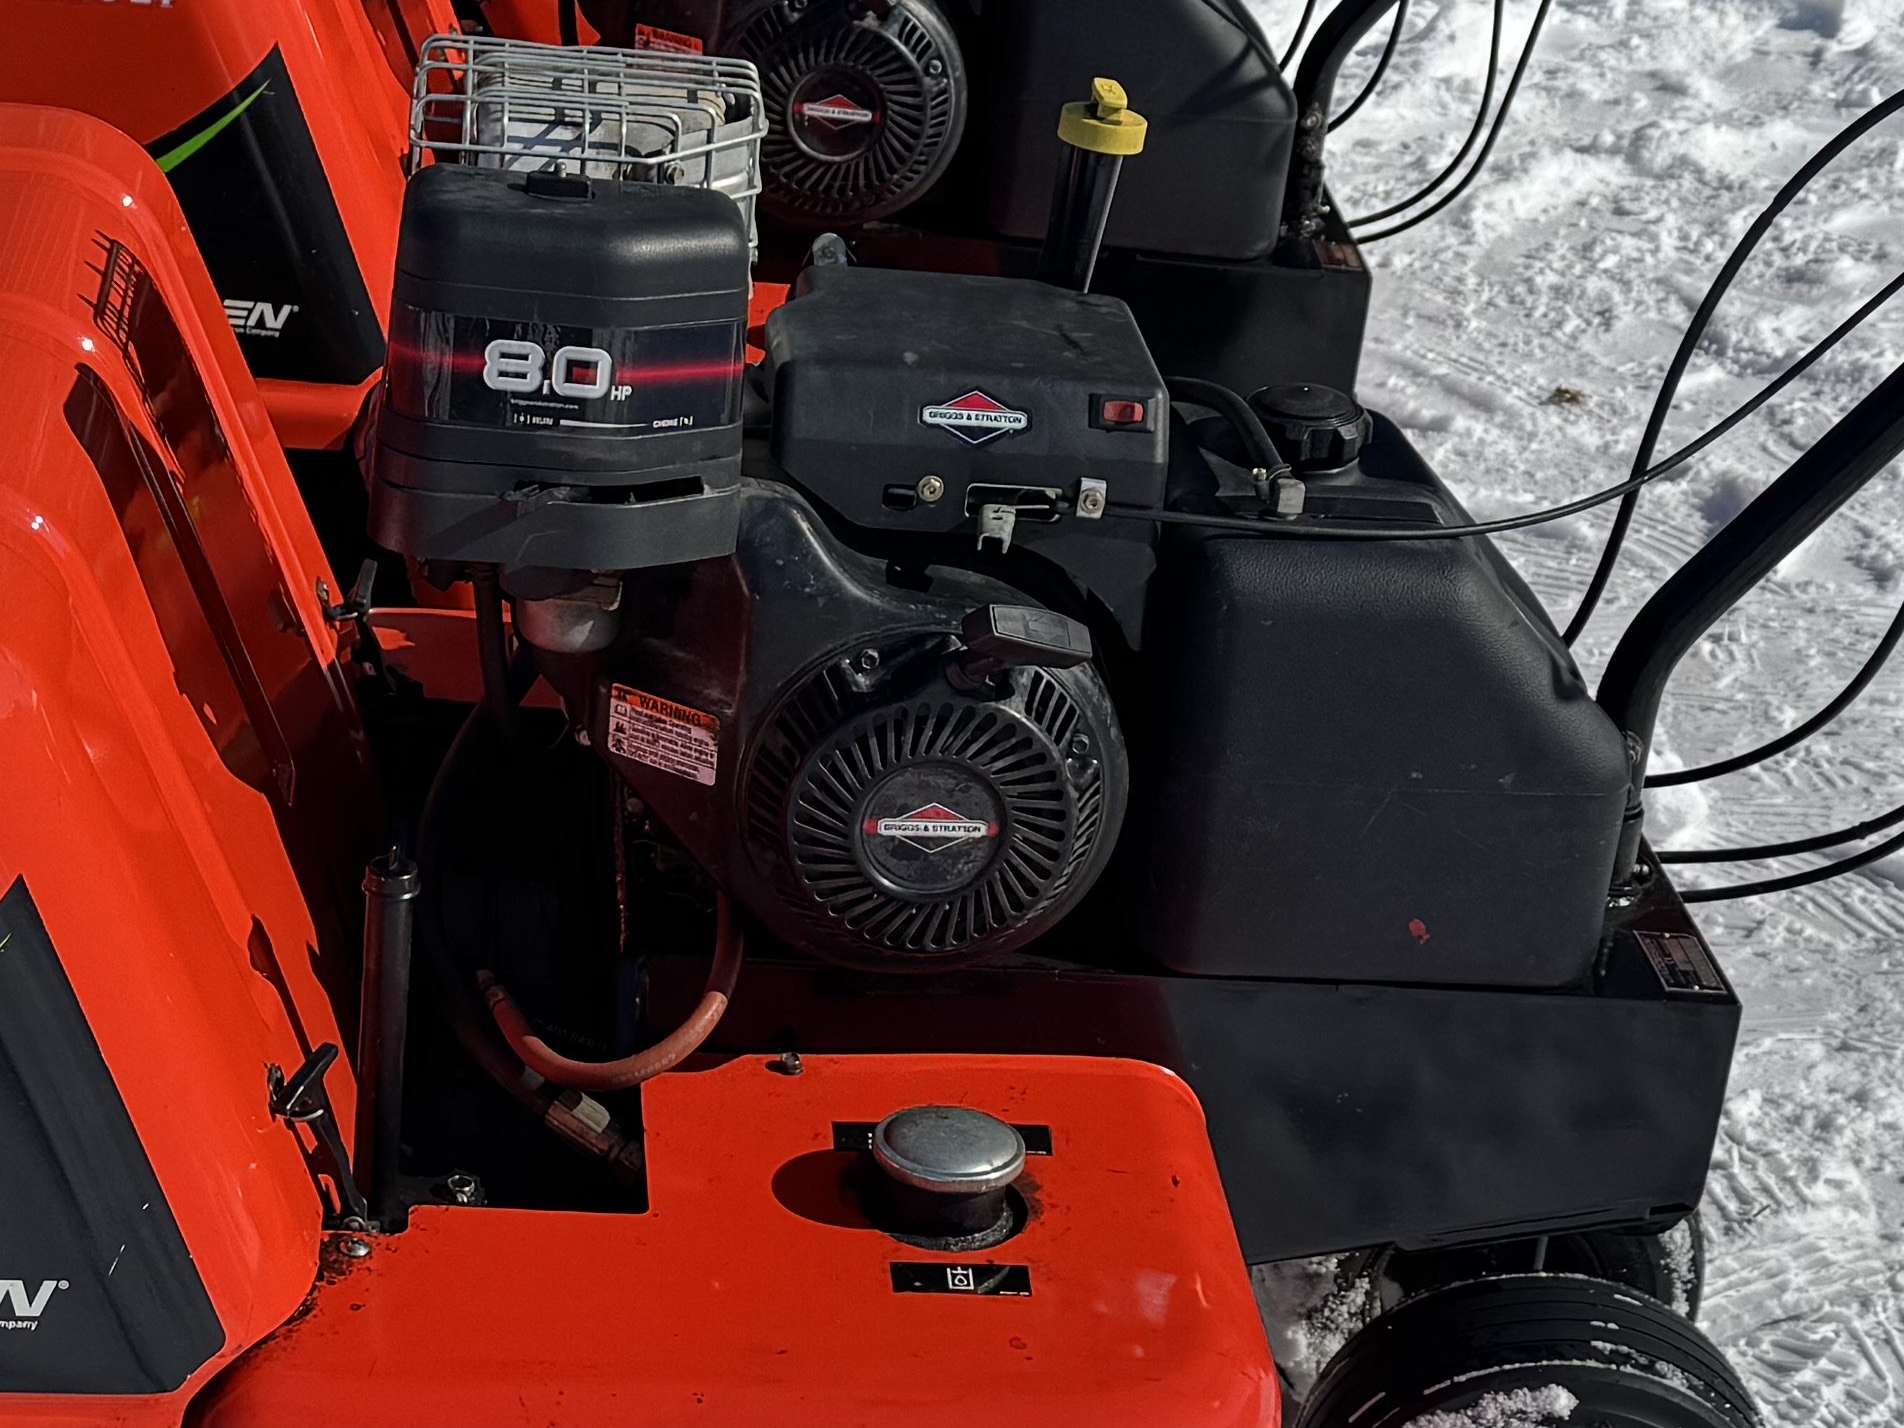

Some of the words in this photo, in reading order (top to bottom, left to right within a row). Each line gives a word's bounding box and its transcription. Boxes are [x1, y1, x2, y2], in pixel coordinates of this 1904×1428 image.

[482, 339, 613, 399] 8.0
[610, 384, 633, 402] HP
[639, 695, 702, 726] WARNING
